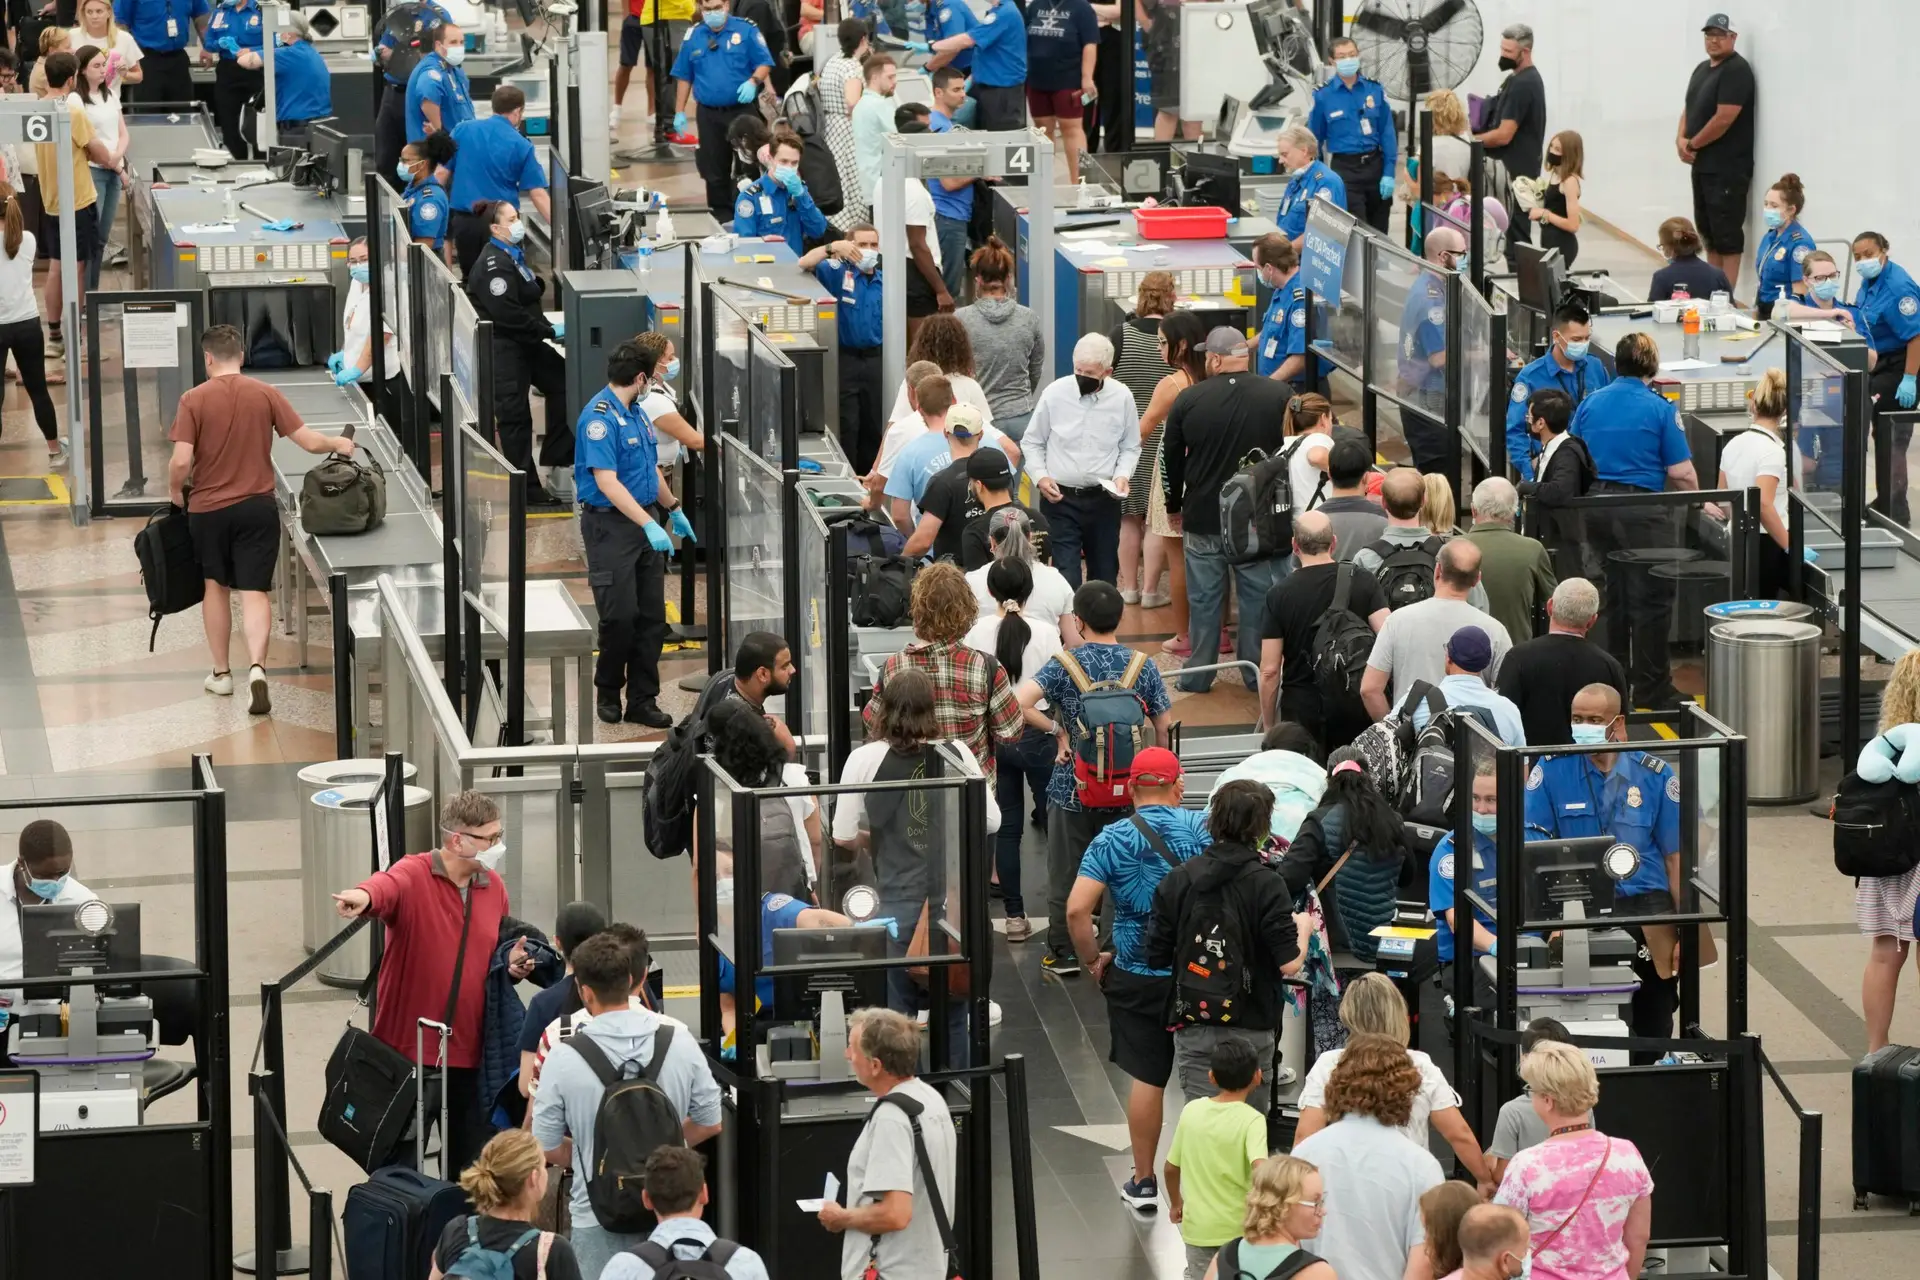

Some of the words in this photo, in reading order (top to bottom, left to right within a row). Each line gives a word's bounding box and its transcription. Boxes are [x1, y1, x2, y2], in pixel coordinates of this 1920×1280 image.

[1036, 8, 1071, 19] DALLAS
[1028, 28, 1065, 38] COWBOYS
[26, 115, 48, 142] 6
[1009, 146, 1031, 173] 4
